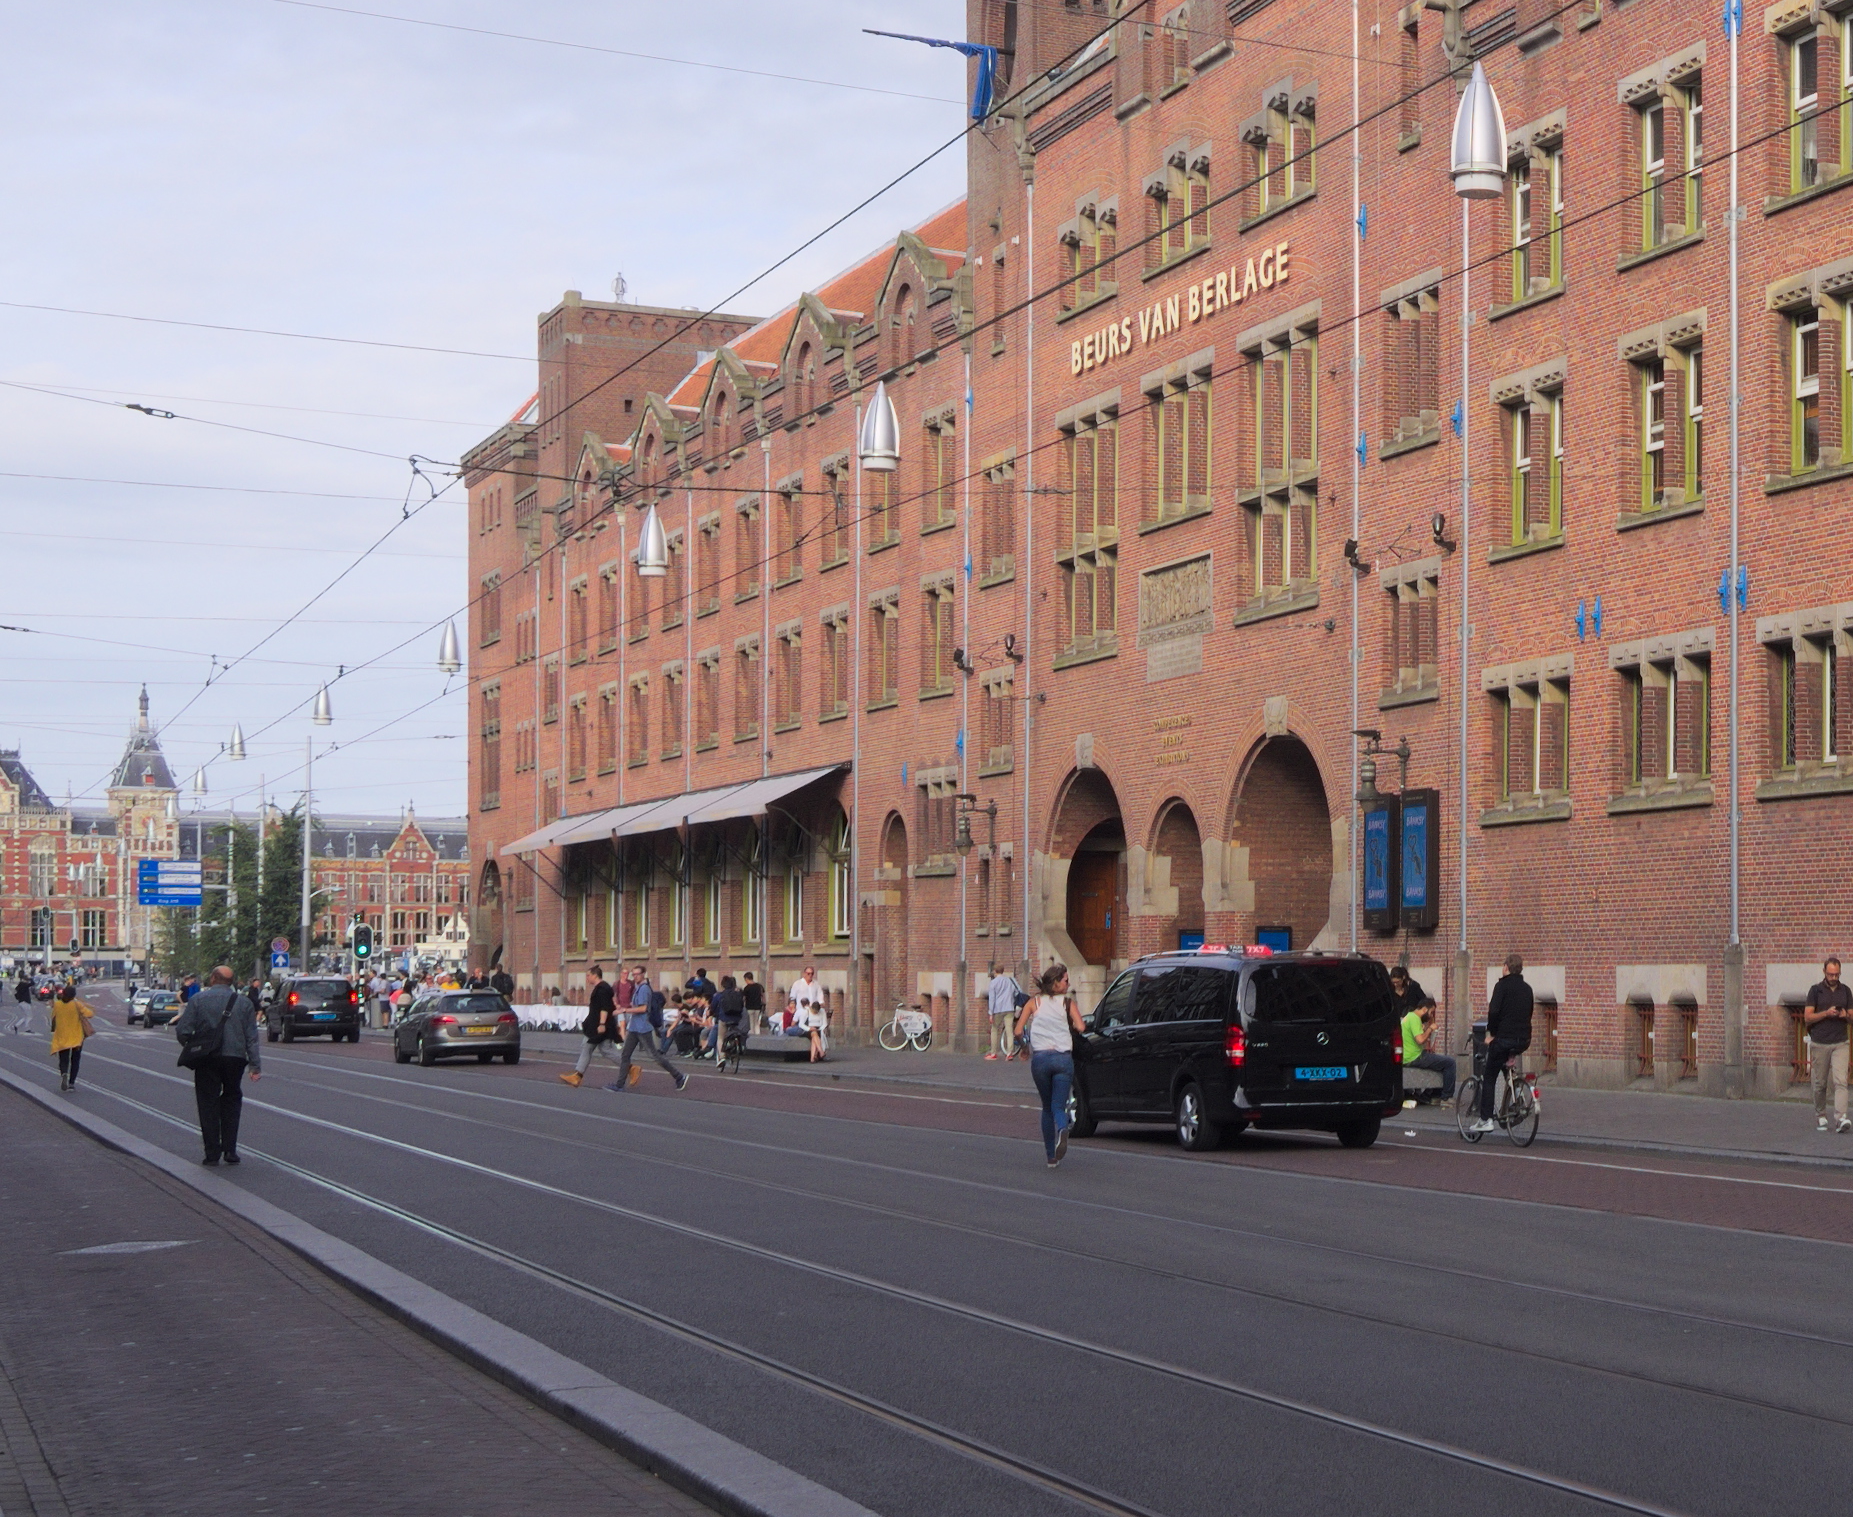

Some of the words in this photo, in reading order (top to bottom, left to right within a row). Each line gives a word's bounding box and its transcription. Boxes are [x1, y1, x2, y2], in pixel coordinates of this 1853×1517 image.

[1071, 316, 1132, 375] BEURS
[1138, 294, 1180, 343] VAN
[1188, 241, 1290, 322] BERLAGE
[1368, 819, 1386, 830] BANKSY
[1406, 816, 1425, 827] BANKSY
[1368, 889, 1386, 900] BANKSY
[1406, 887, 1424, 898] BANKSY
[1301, 1068, 1342, 1078] 4-XKX-02
